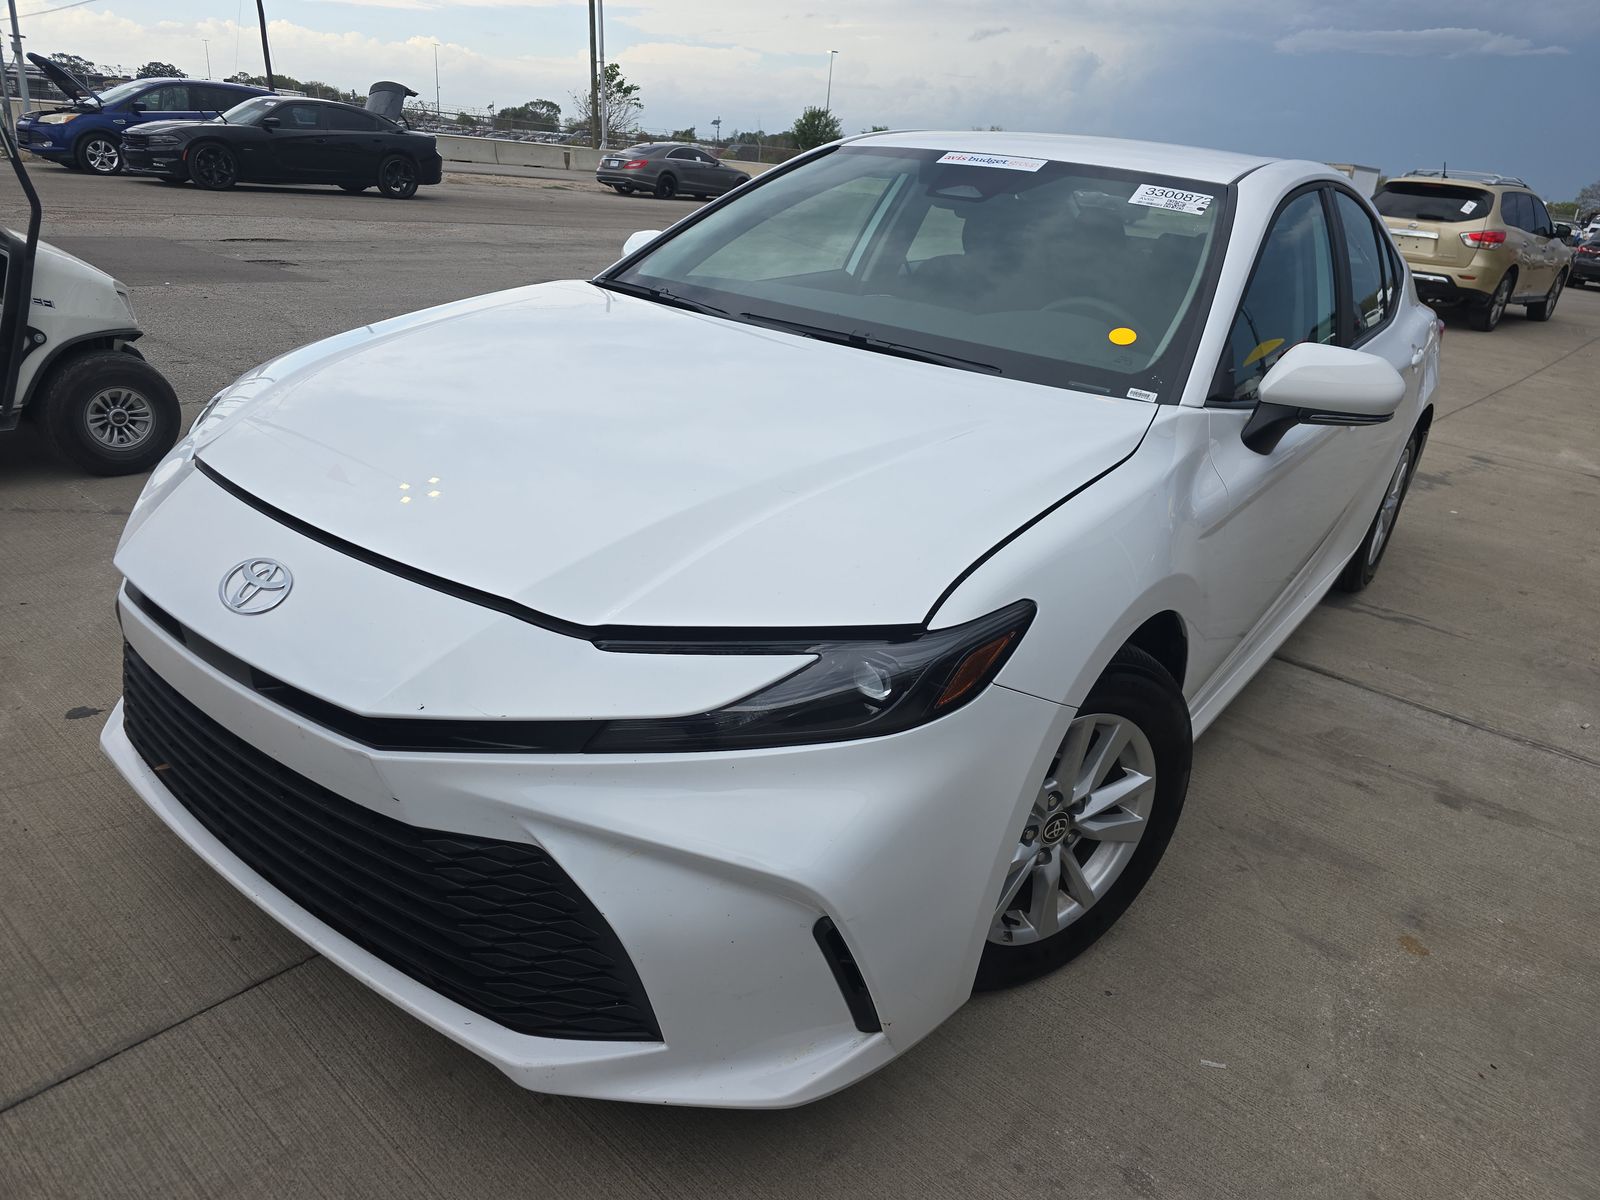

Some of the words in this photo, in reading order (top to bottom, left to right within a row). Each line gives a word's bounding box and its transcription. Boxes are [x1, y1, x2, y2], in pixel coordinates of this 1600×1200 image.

[943, 154, 967, 162] avis
[967, 156, 1009, 166] budget
[1145, 187, 1212, 205] 3300872
